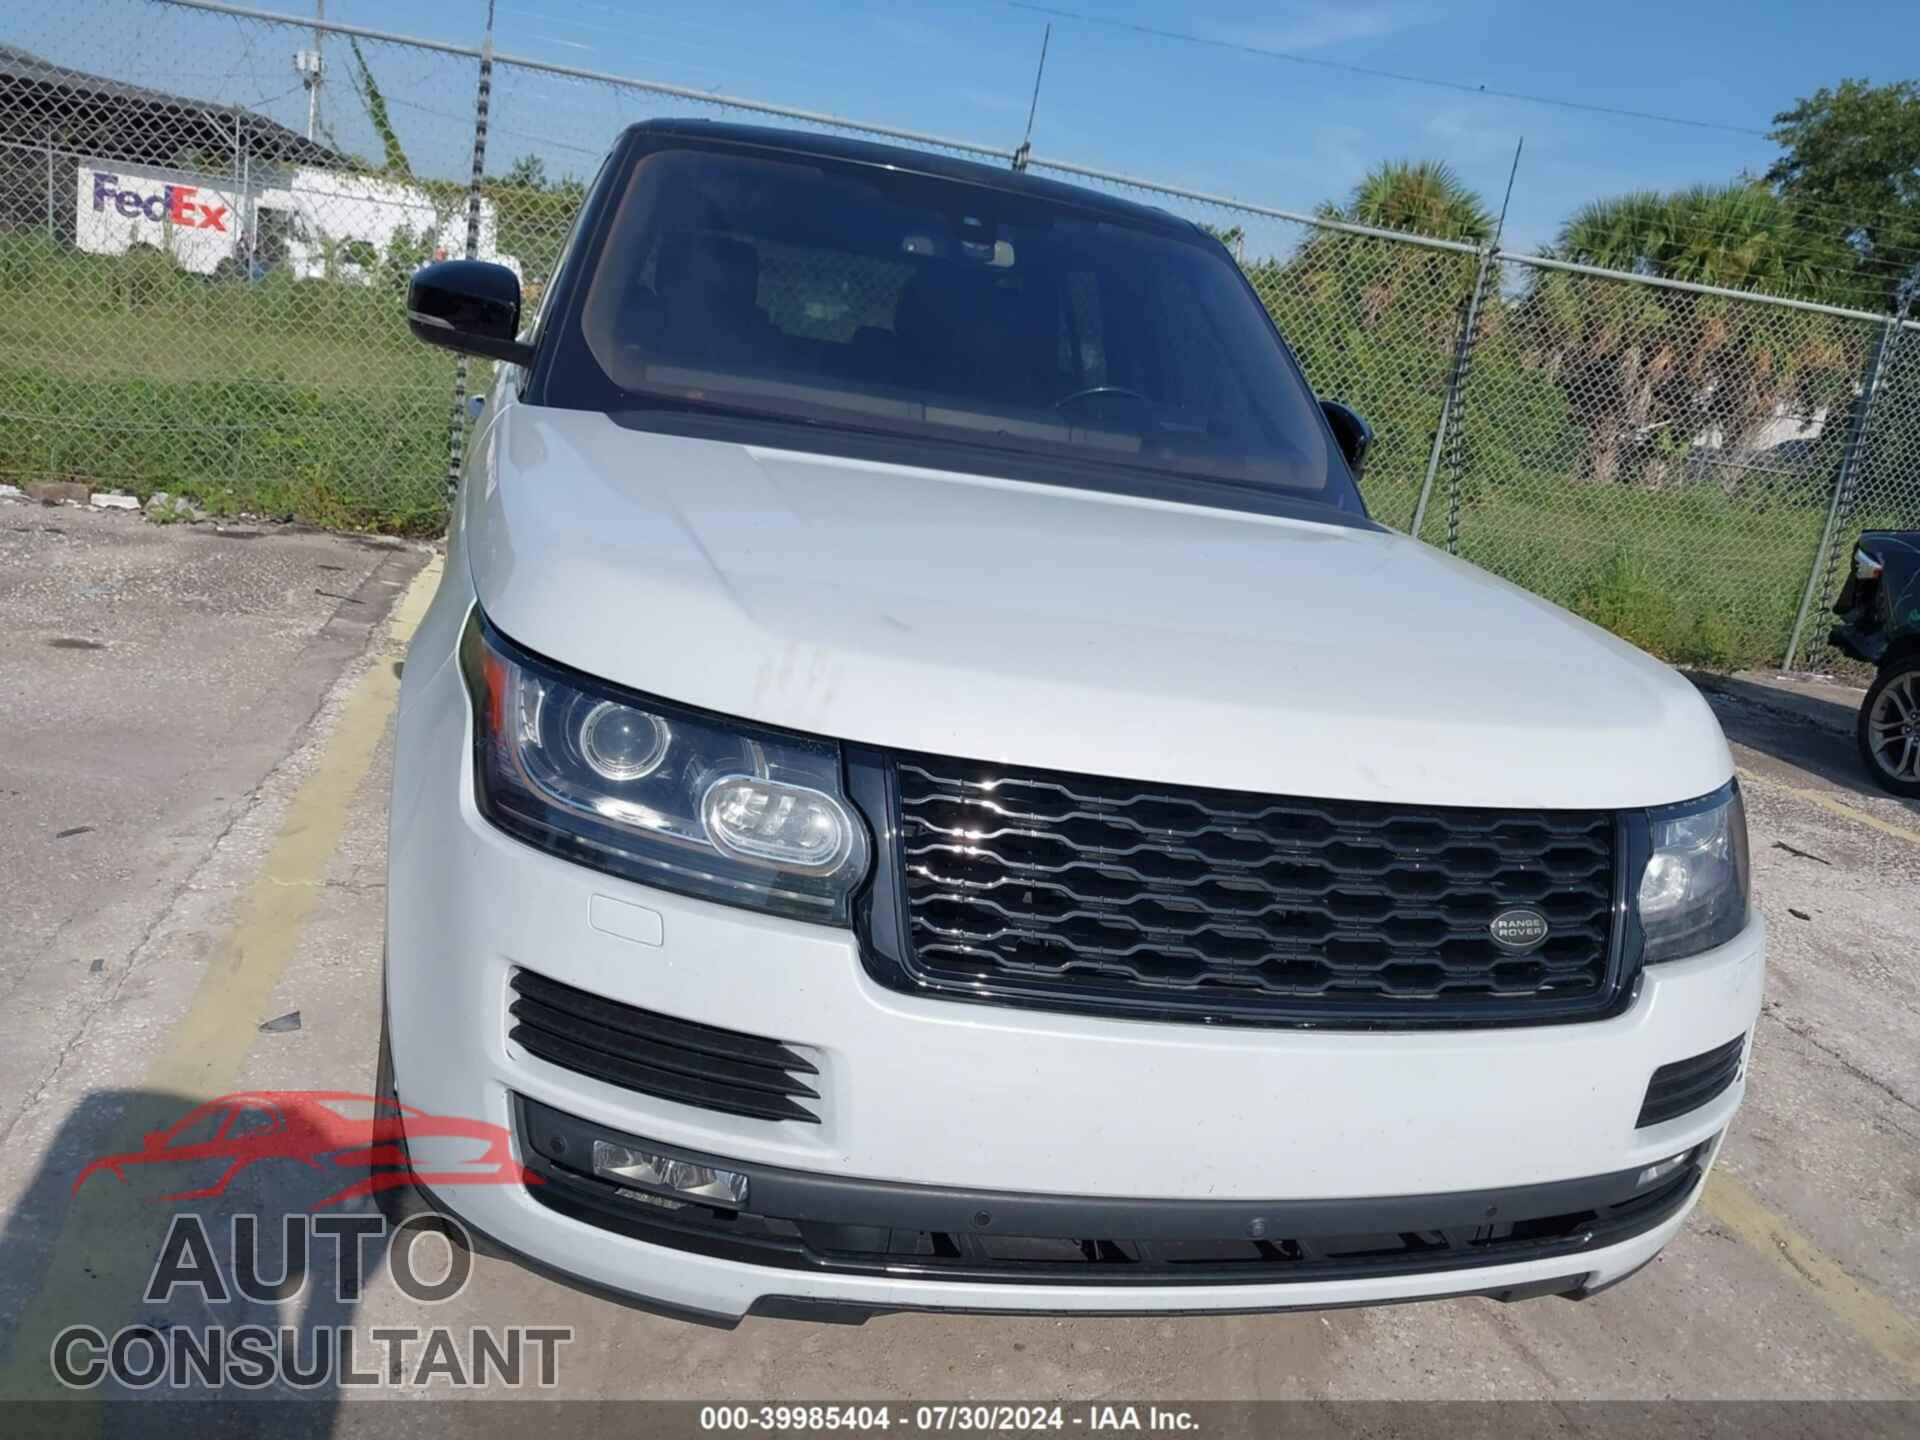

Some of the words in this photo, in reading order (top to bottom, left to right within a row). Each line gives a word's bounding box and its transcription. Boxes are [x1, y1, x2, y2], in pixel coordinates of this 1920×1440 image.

[93, 172, 227, 232] FedEx
[1498, 919, 1541, 929] RANGE
[1498, 928, 1542, 937] ROVER
